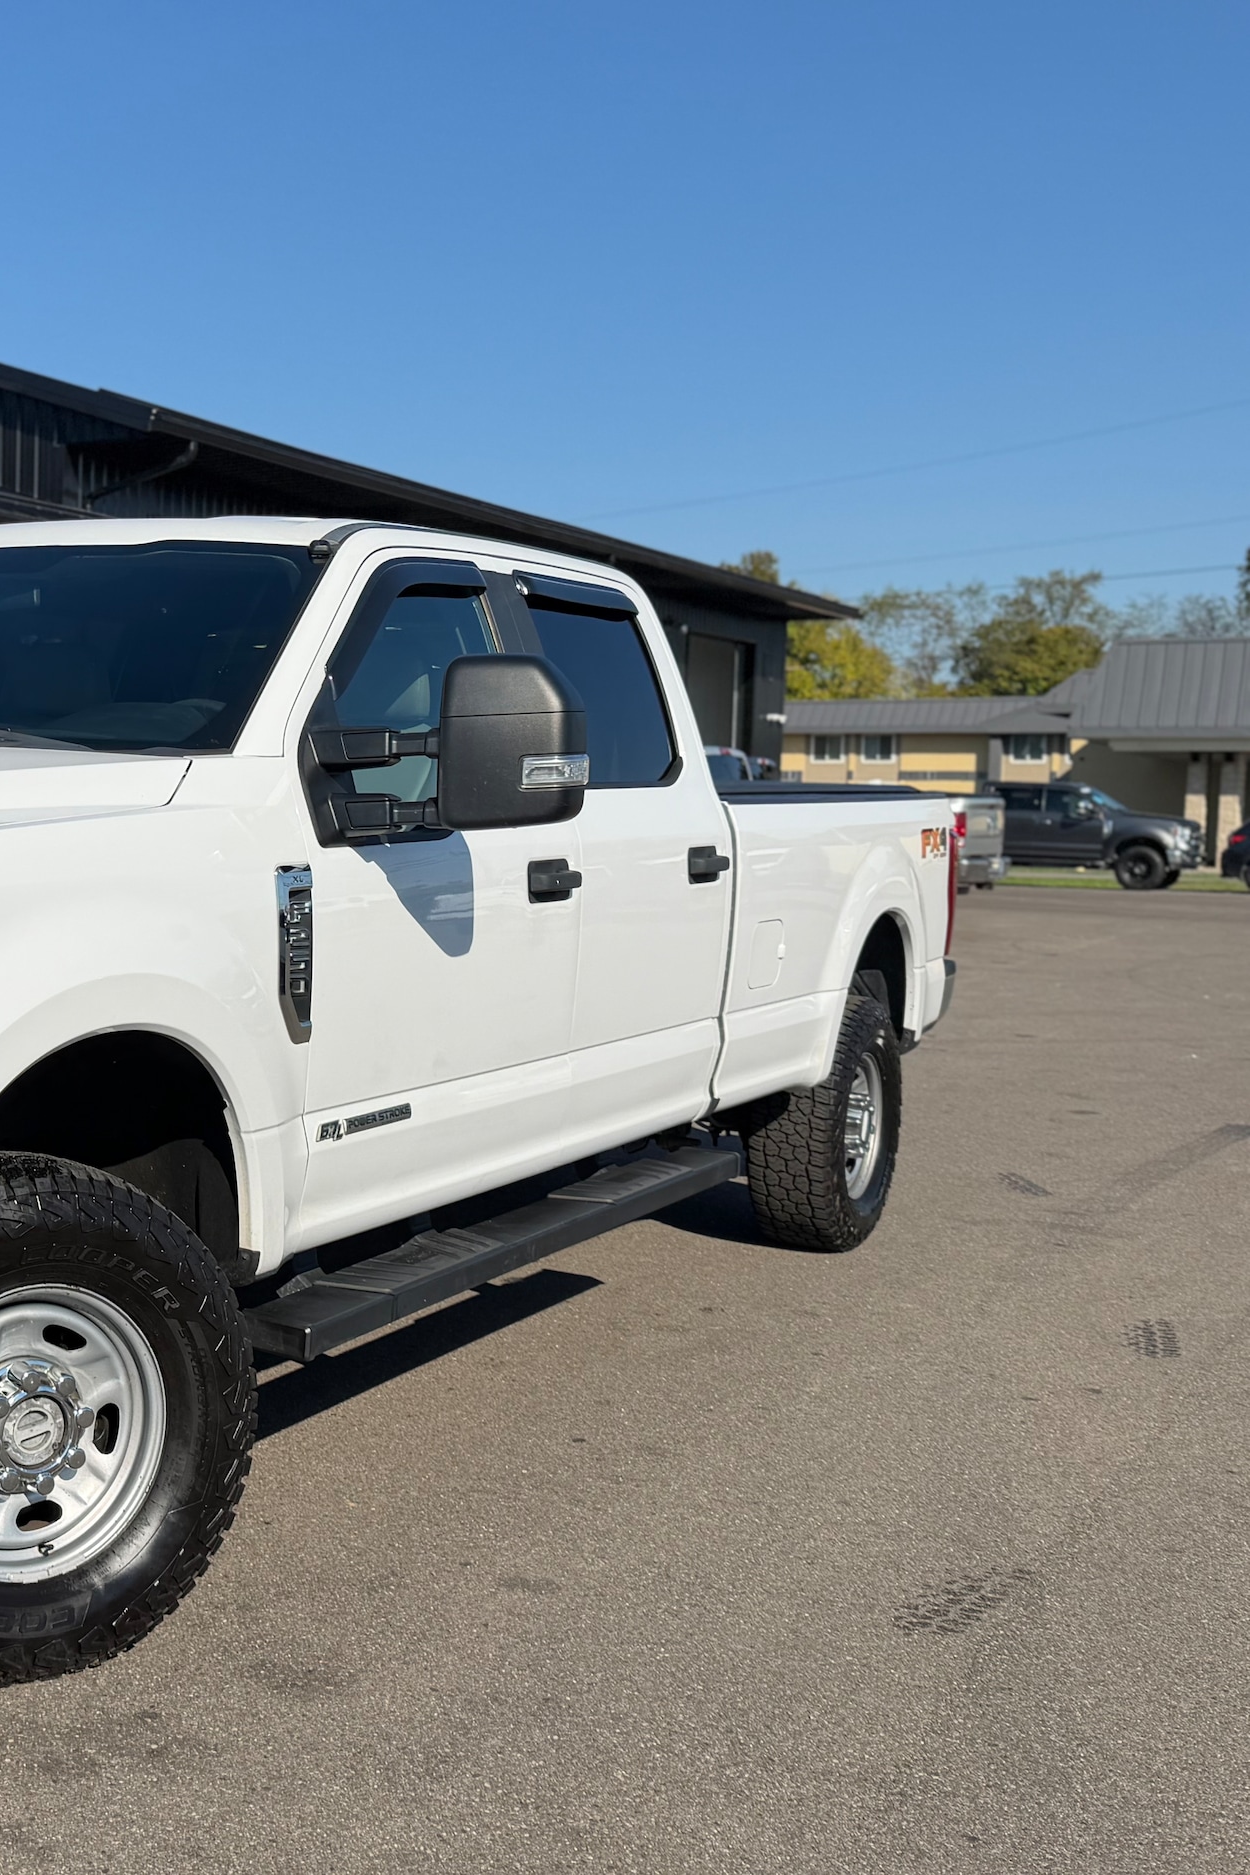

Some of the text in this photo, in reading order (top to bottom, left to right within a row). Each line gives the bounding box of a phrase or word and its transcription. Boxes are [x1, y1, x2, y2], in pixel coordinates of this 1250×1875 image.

[921, 827, 947, 858] FX4
[292, 875, 304, 884] XL
[348, 1114, 377, 1129] POWER
[378, 1105, 411, 1122] STROKE
[20, 1243, 180, 1314] COOPER
